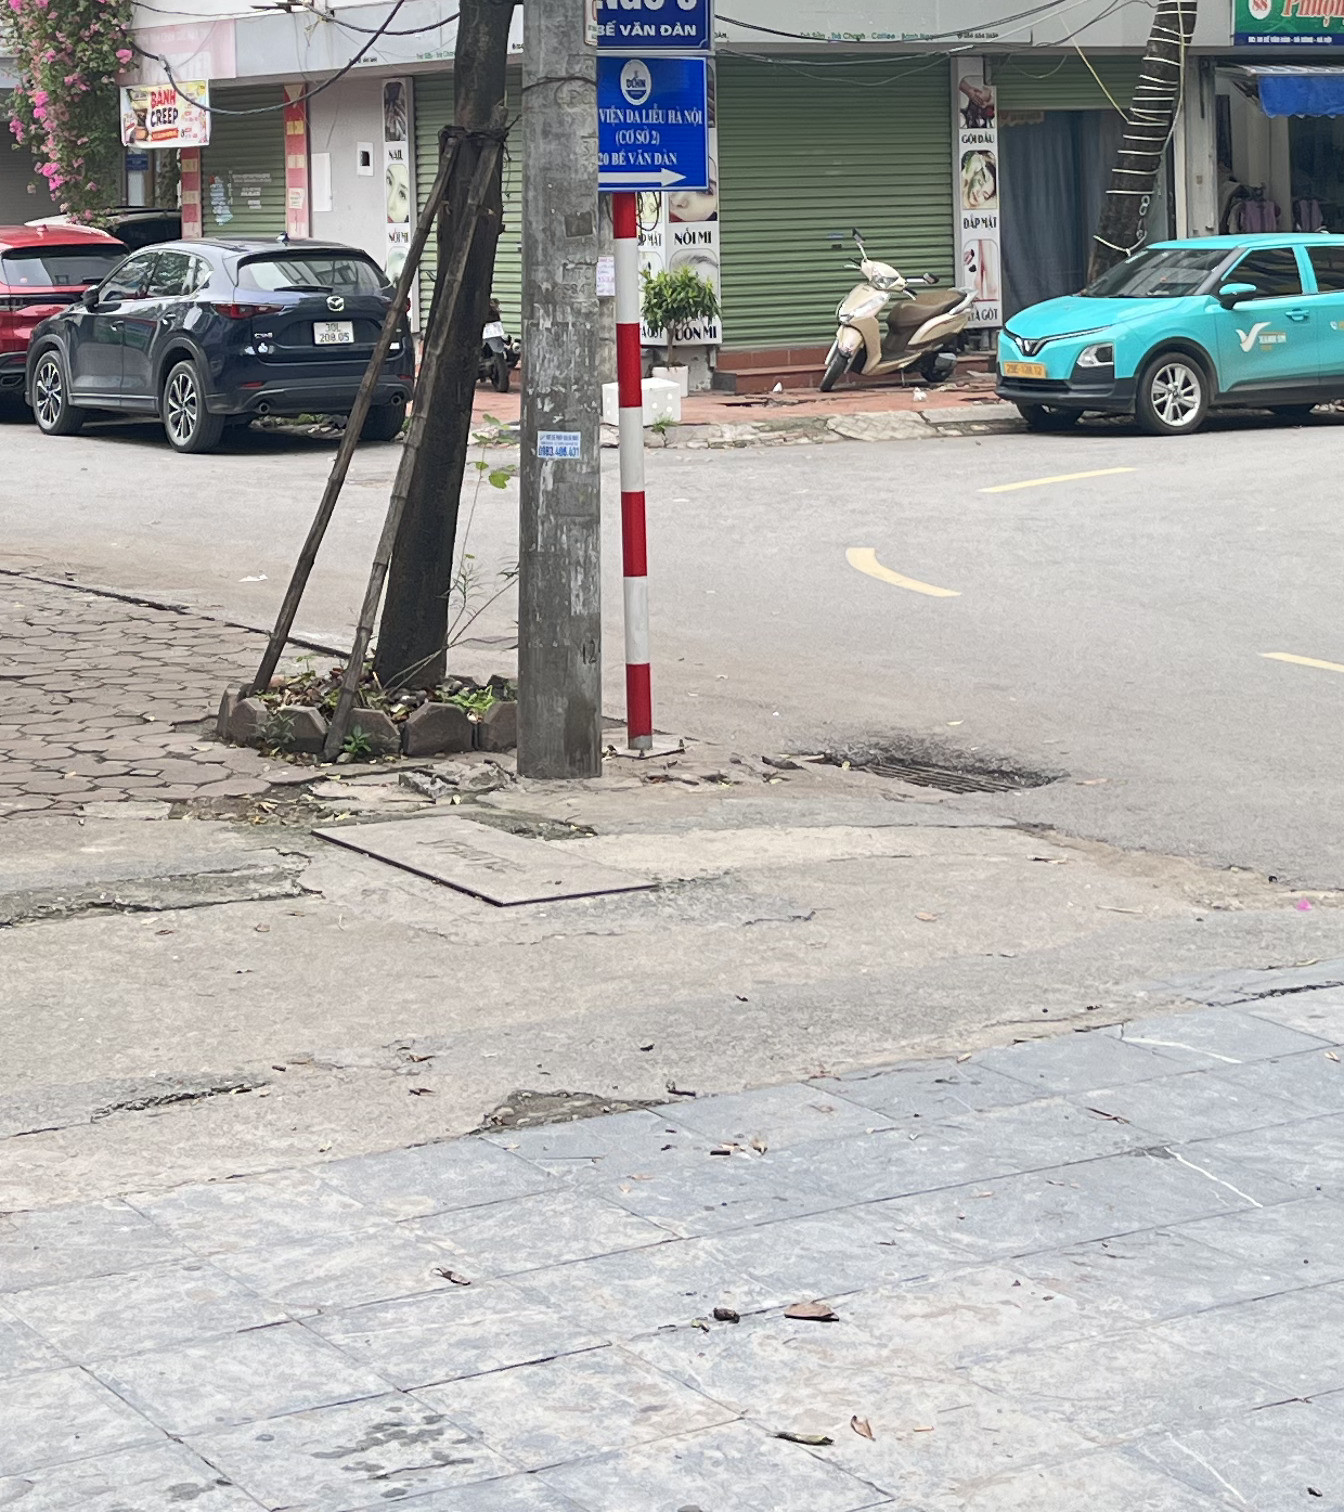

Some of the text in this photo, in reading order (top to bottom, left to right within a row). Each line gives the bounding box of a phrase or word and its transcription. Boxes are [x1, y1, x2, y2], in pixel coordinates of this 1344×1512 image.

[597, 20, 617, 37] BẾ
[619, 21, 656, 37] VĂN
[659, 22, 697, 37] ĐÀN
[599, 104, 625, 126] VIỆN
[626, 108, 641, 124] DA
[667, 104, 683, 124] HÀ
[685, 105, 703, 128] NỘI
[650, 129, 660, 146] 2)
[674, 227, 696, 245] NỐI
[697, 231, 712, 244] MI
[705, 326, 717, 339] MI
